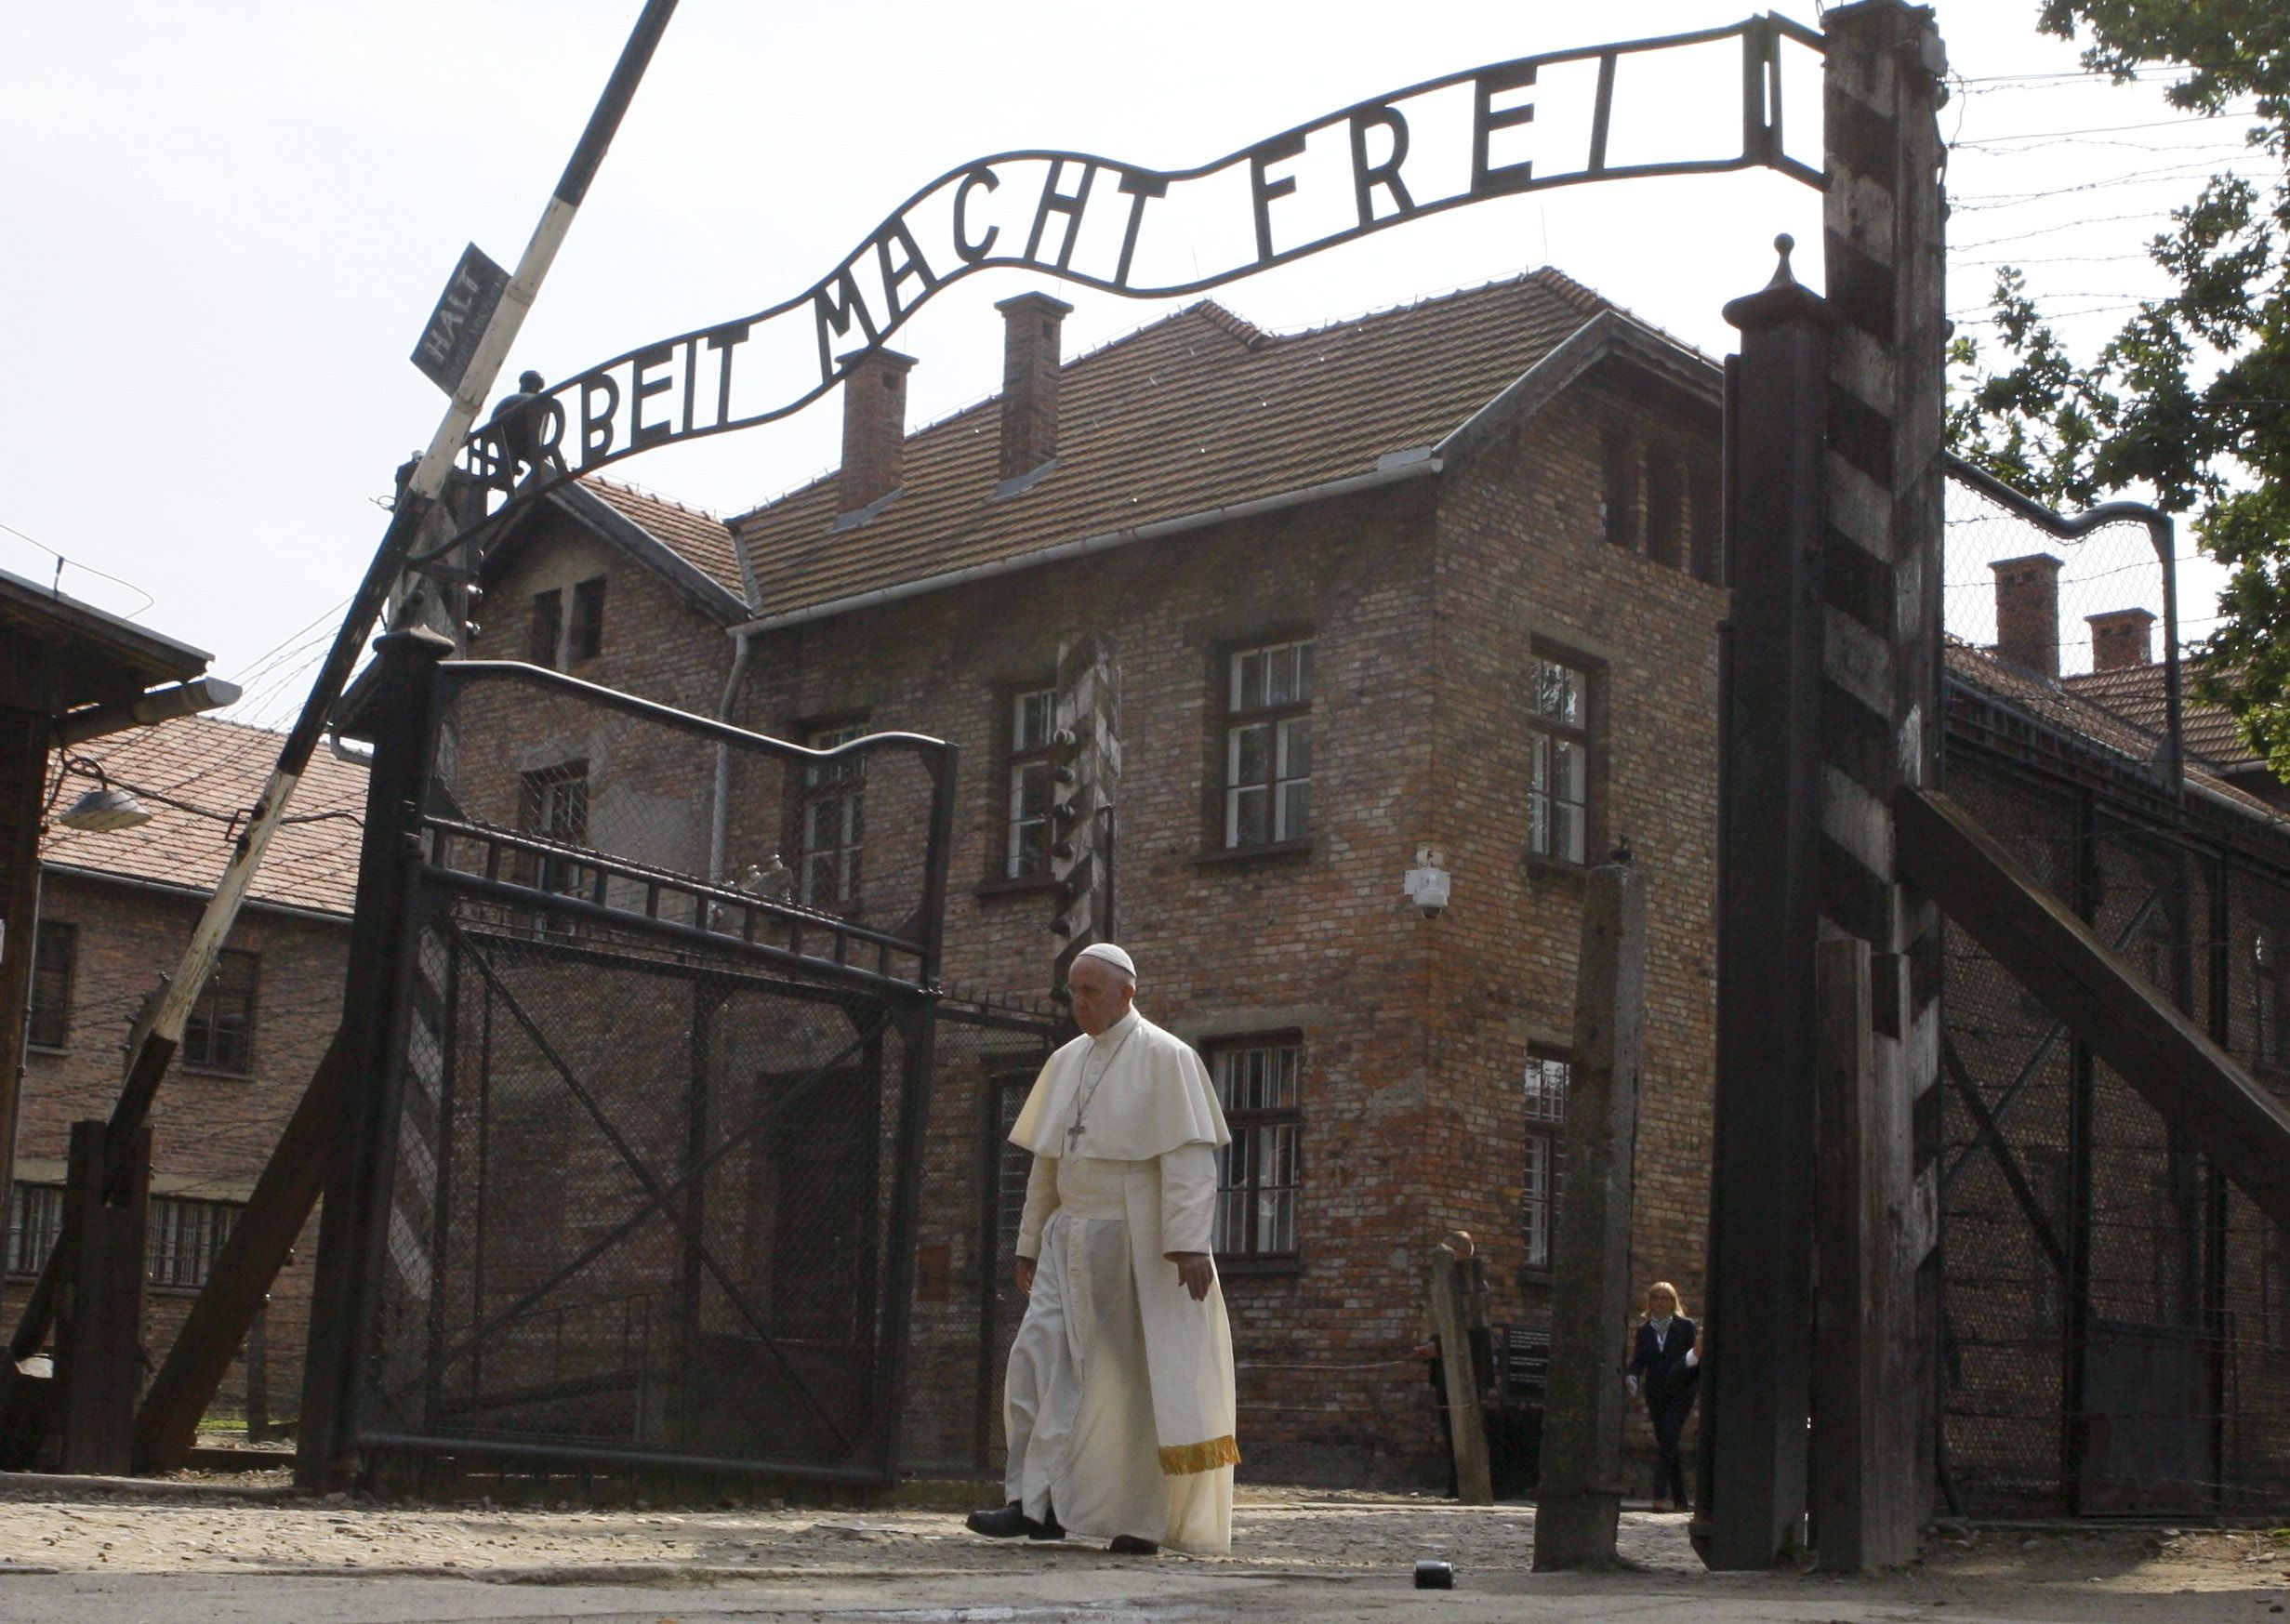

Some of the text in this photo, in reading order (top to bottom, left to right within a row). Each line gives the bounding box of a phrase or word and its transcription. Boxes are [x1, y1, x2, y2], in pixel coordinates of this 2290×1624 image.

[423, 264, 480, 363] HALT
[814, 155, 1170, 384] MACHT
[1251, 53, 1618, 264] FREI
